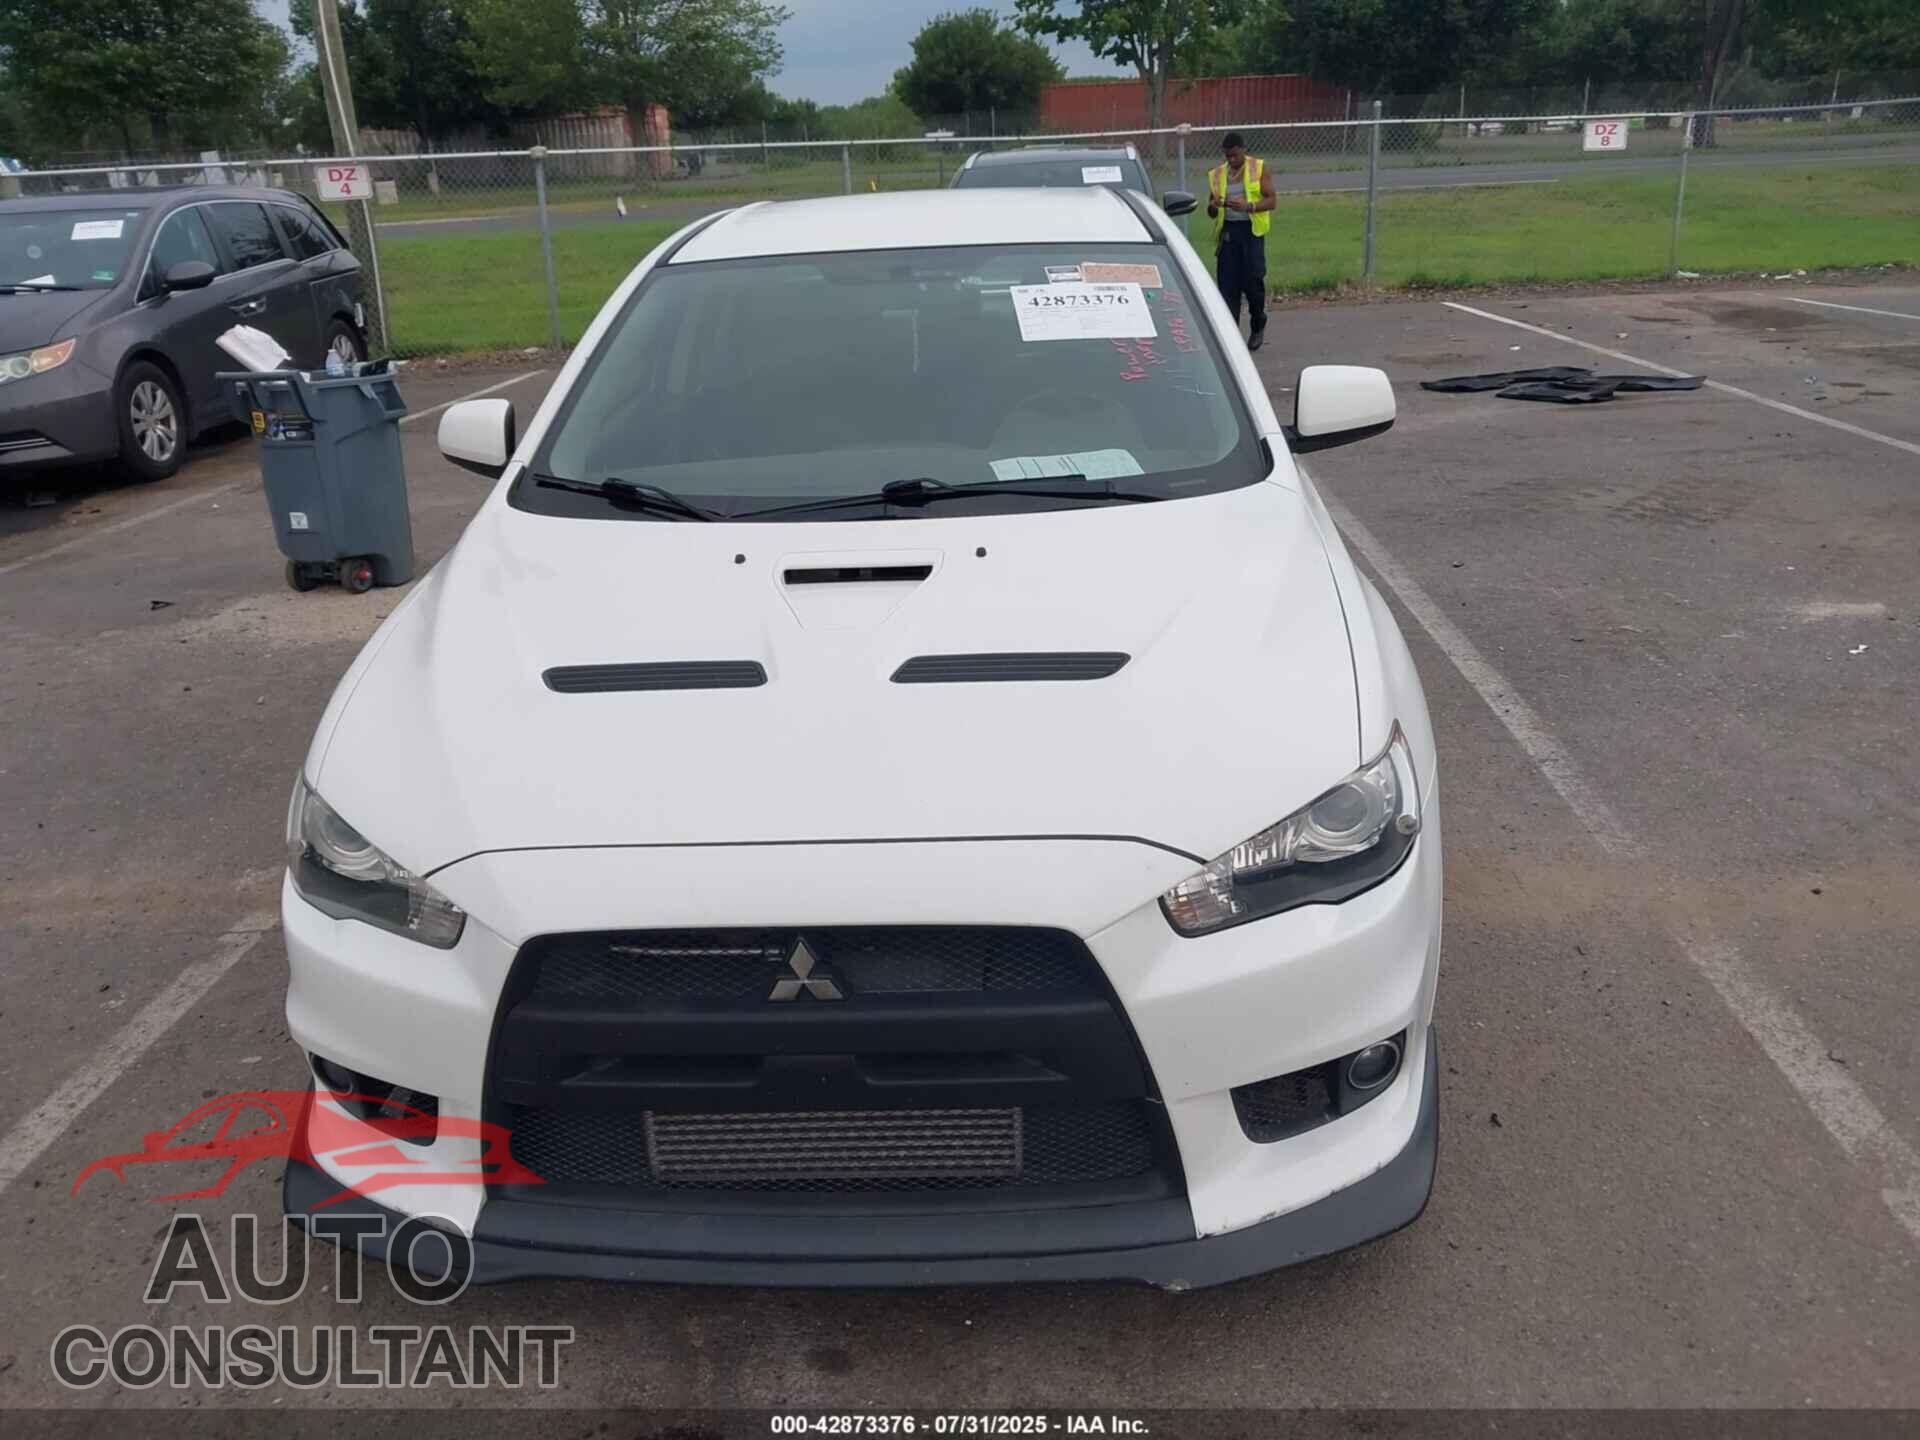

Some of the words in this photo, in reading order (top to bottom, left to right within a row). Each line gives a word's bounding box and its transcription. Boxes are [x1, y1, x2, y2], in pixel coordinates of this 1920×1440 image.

[1595, 124, 1618, 136] DZ
[1601, 136, 1610, 146] 8
[328, 168, 358, 182] DZ
[341, 183, 352, 194] 4
[1028, 294, 1130, 307] 42873376
